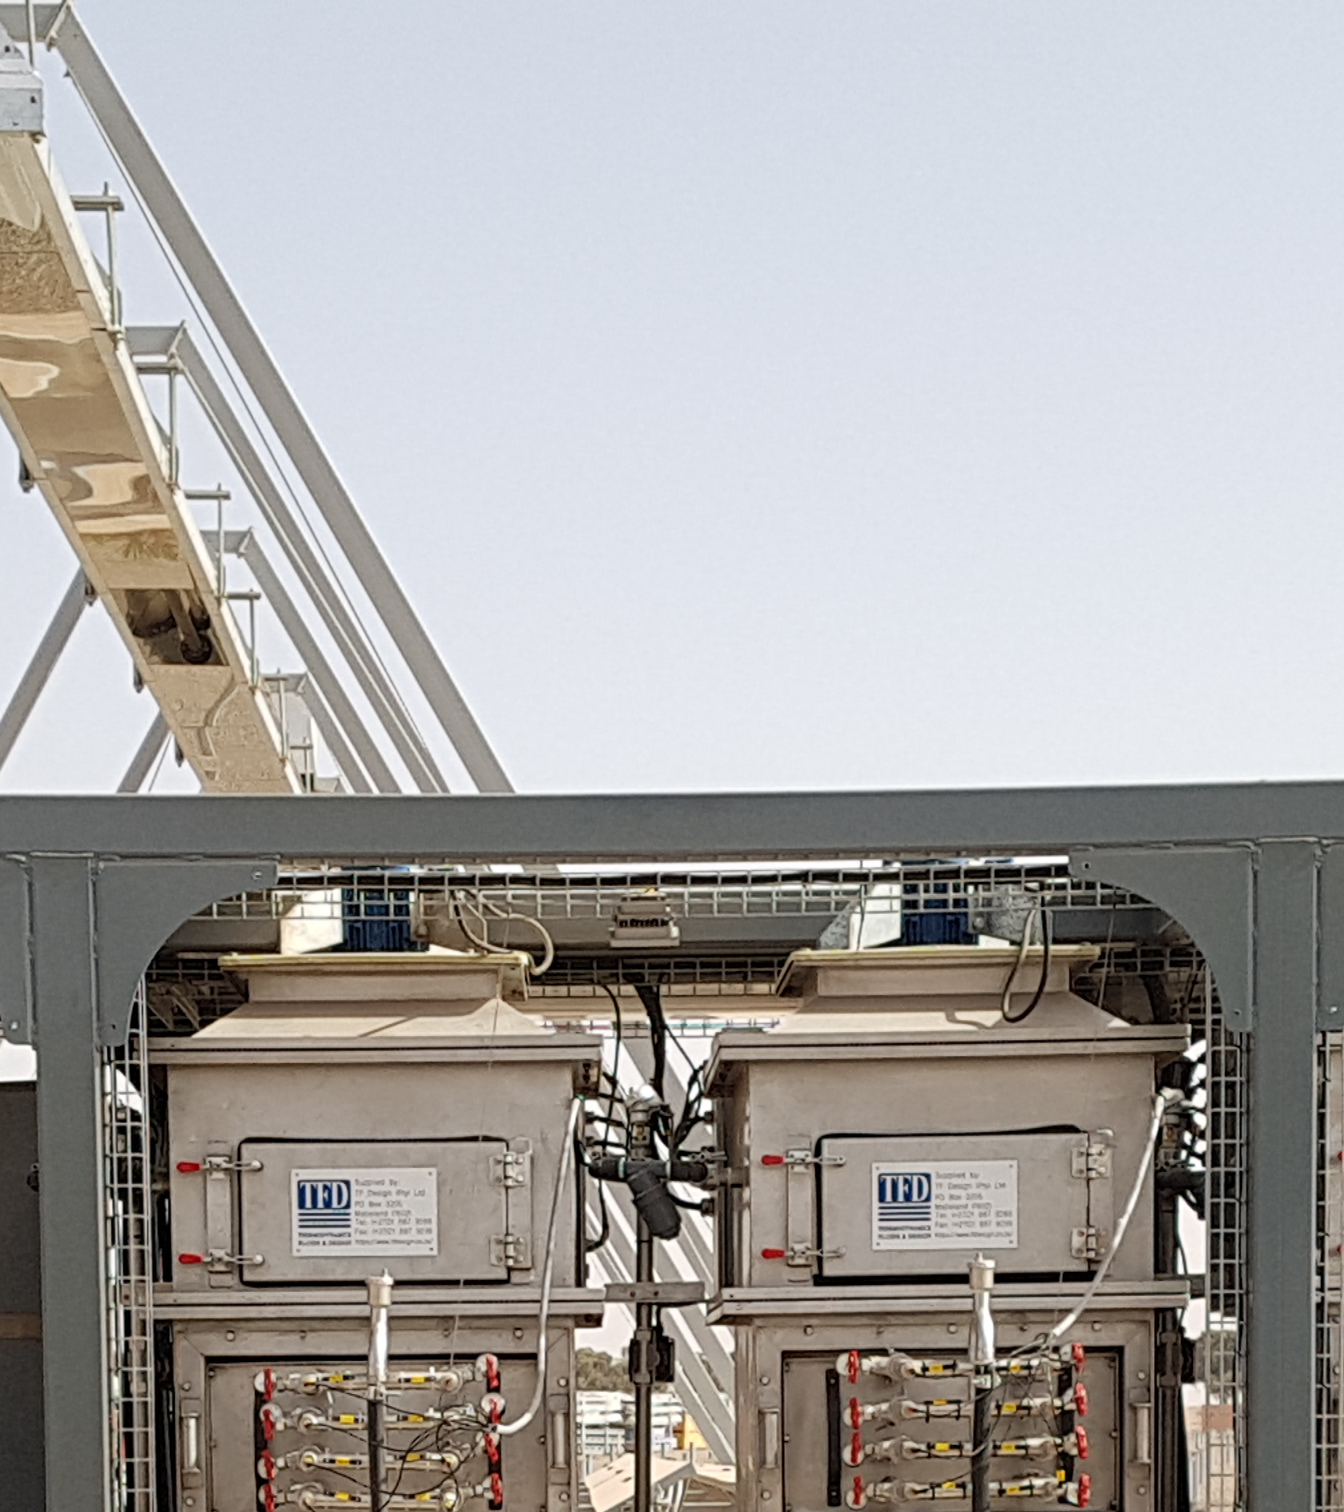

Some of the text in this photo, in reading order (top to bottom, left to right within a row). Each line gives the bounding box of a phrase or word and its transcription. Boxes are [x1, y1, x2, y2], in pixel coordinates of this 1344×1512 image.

[299, 1181, 349, 1209] TFD
[368, 1189, 392, 1198] Design
[880, 1175, 929, 1202] TFD
